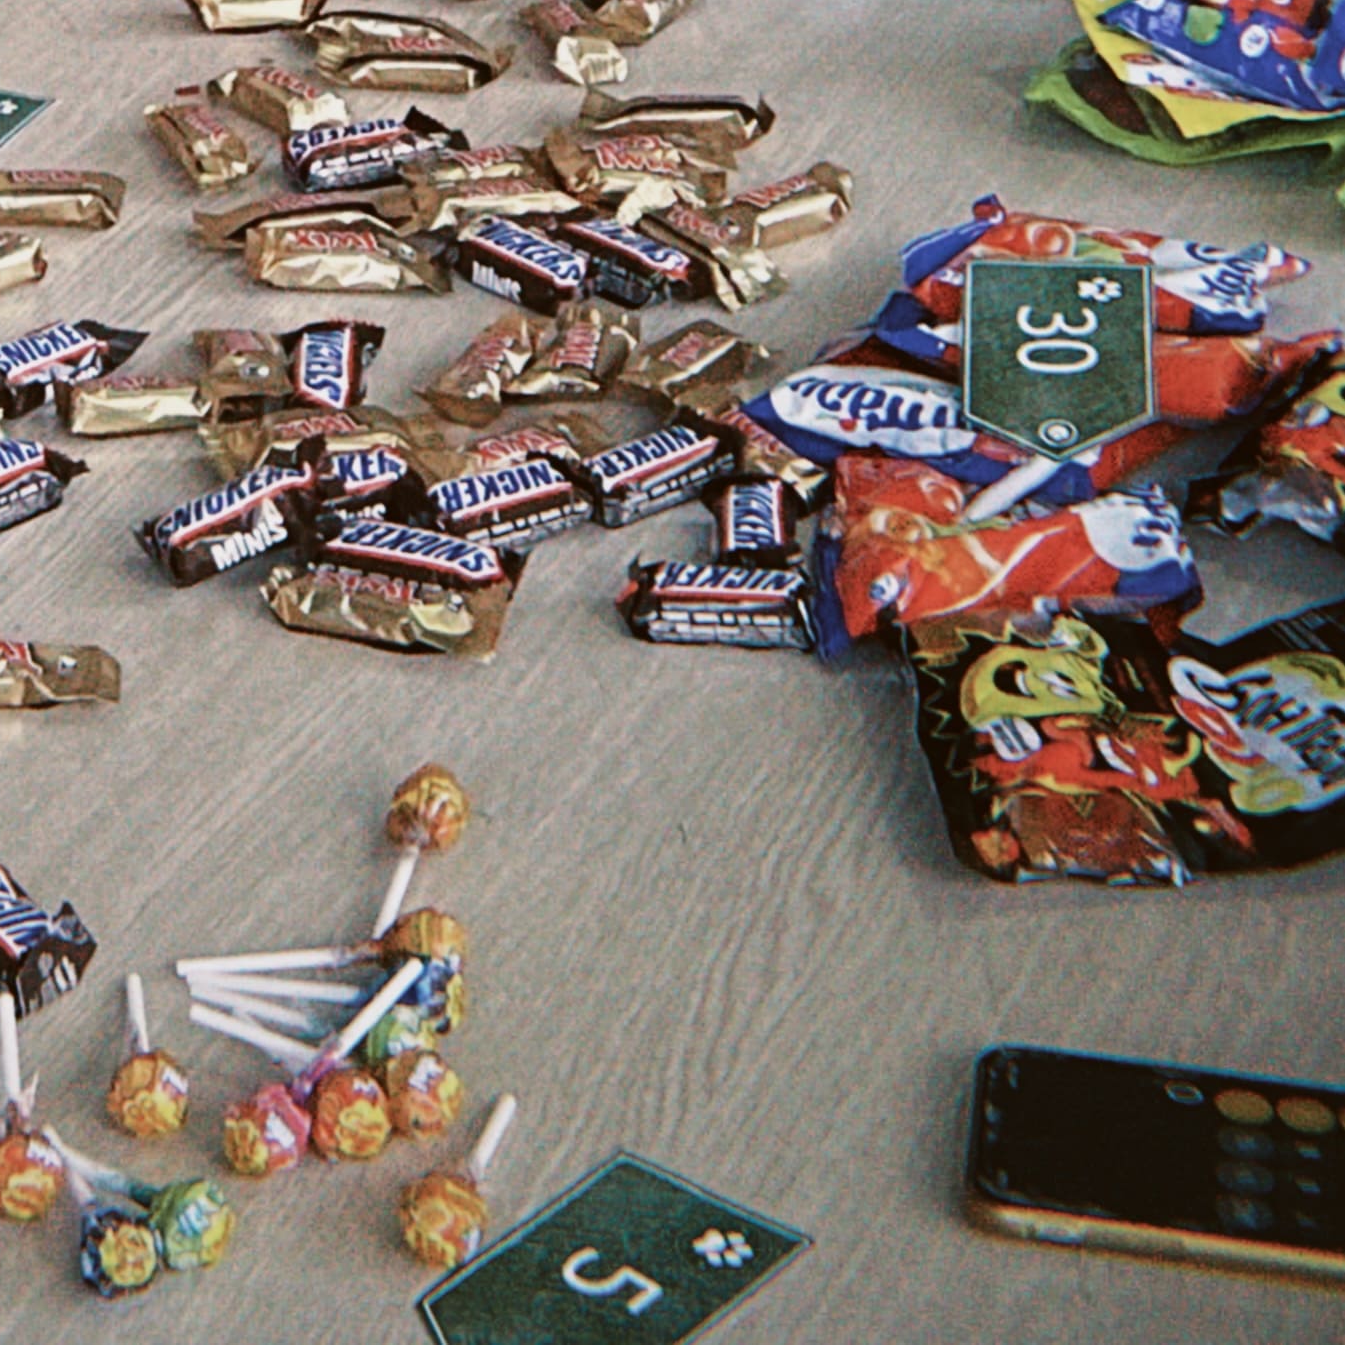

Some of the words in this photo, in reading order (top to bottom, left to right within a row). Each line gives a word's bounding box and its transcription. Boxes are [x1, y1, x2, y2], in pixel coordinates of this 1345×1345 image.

[1016, 304, 1099, 374] 30
[593, 425, 699, 481] NICKER
[434, 459, 564, 514] NICKER
[340, 519, 495, 574] SNICKER
[659, 561, 796, 592] NICKER
[562, 1248, 662, 1314] 5
